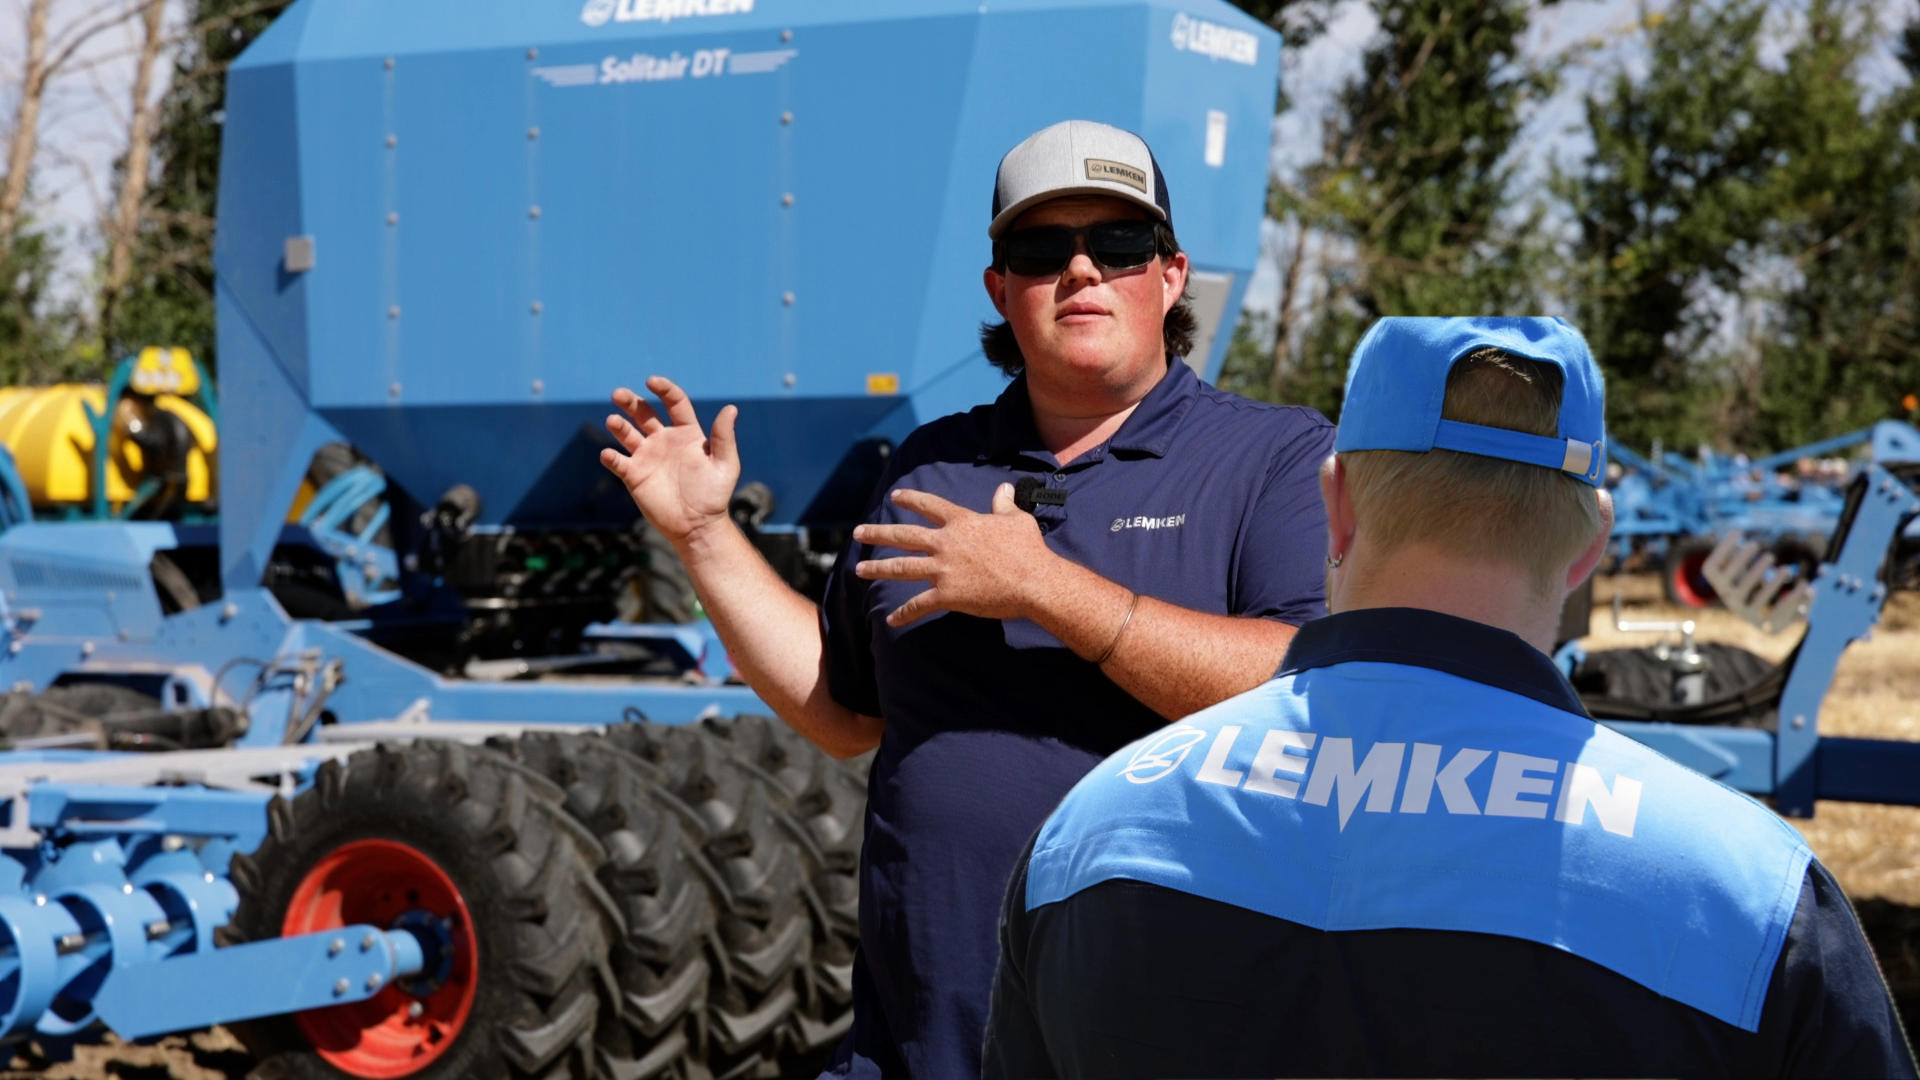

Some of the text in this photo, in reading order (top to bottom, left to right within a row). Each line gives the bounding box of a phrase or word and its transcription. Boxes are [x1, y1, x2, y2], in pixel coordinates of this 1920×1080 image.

[1188, 17, 1259, 67] LEMKEN
[600, 48, 731, 84] Solitair DT
[1103, 164, 1144, 184] LEMKEN
[1125, 513, 1186, 532] LEMKEN
[1194, 725, 1643, 838] LEMKEN
